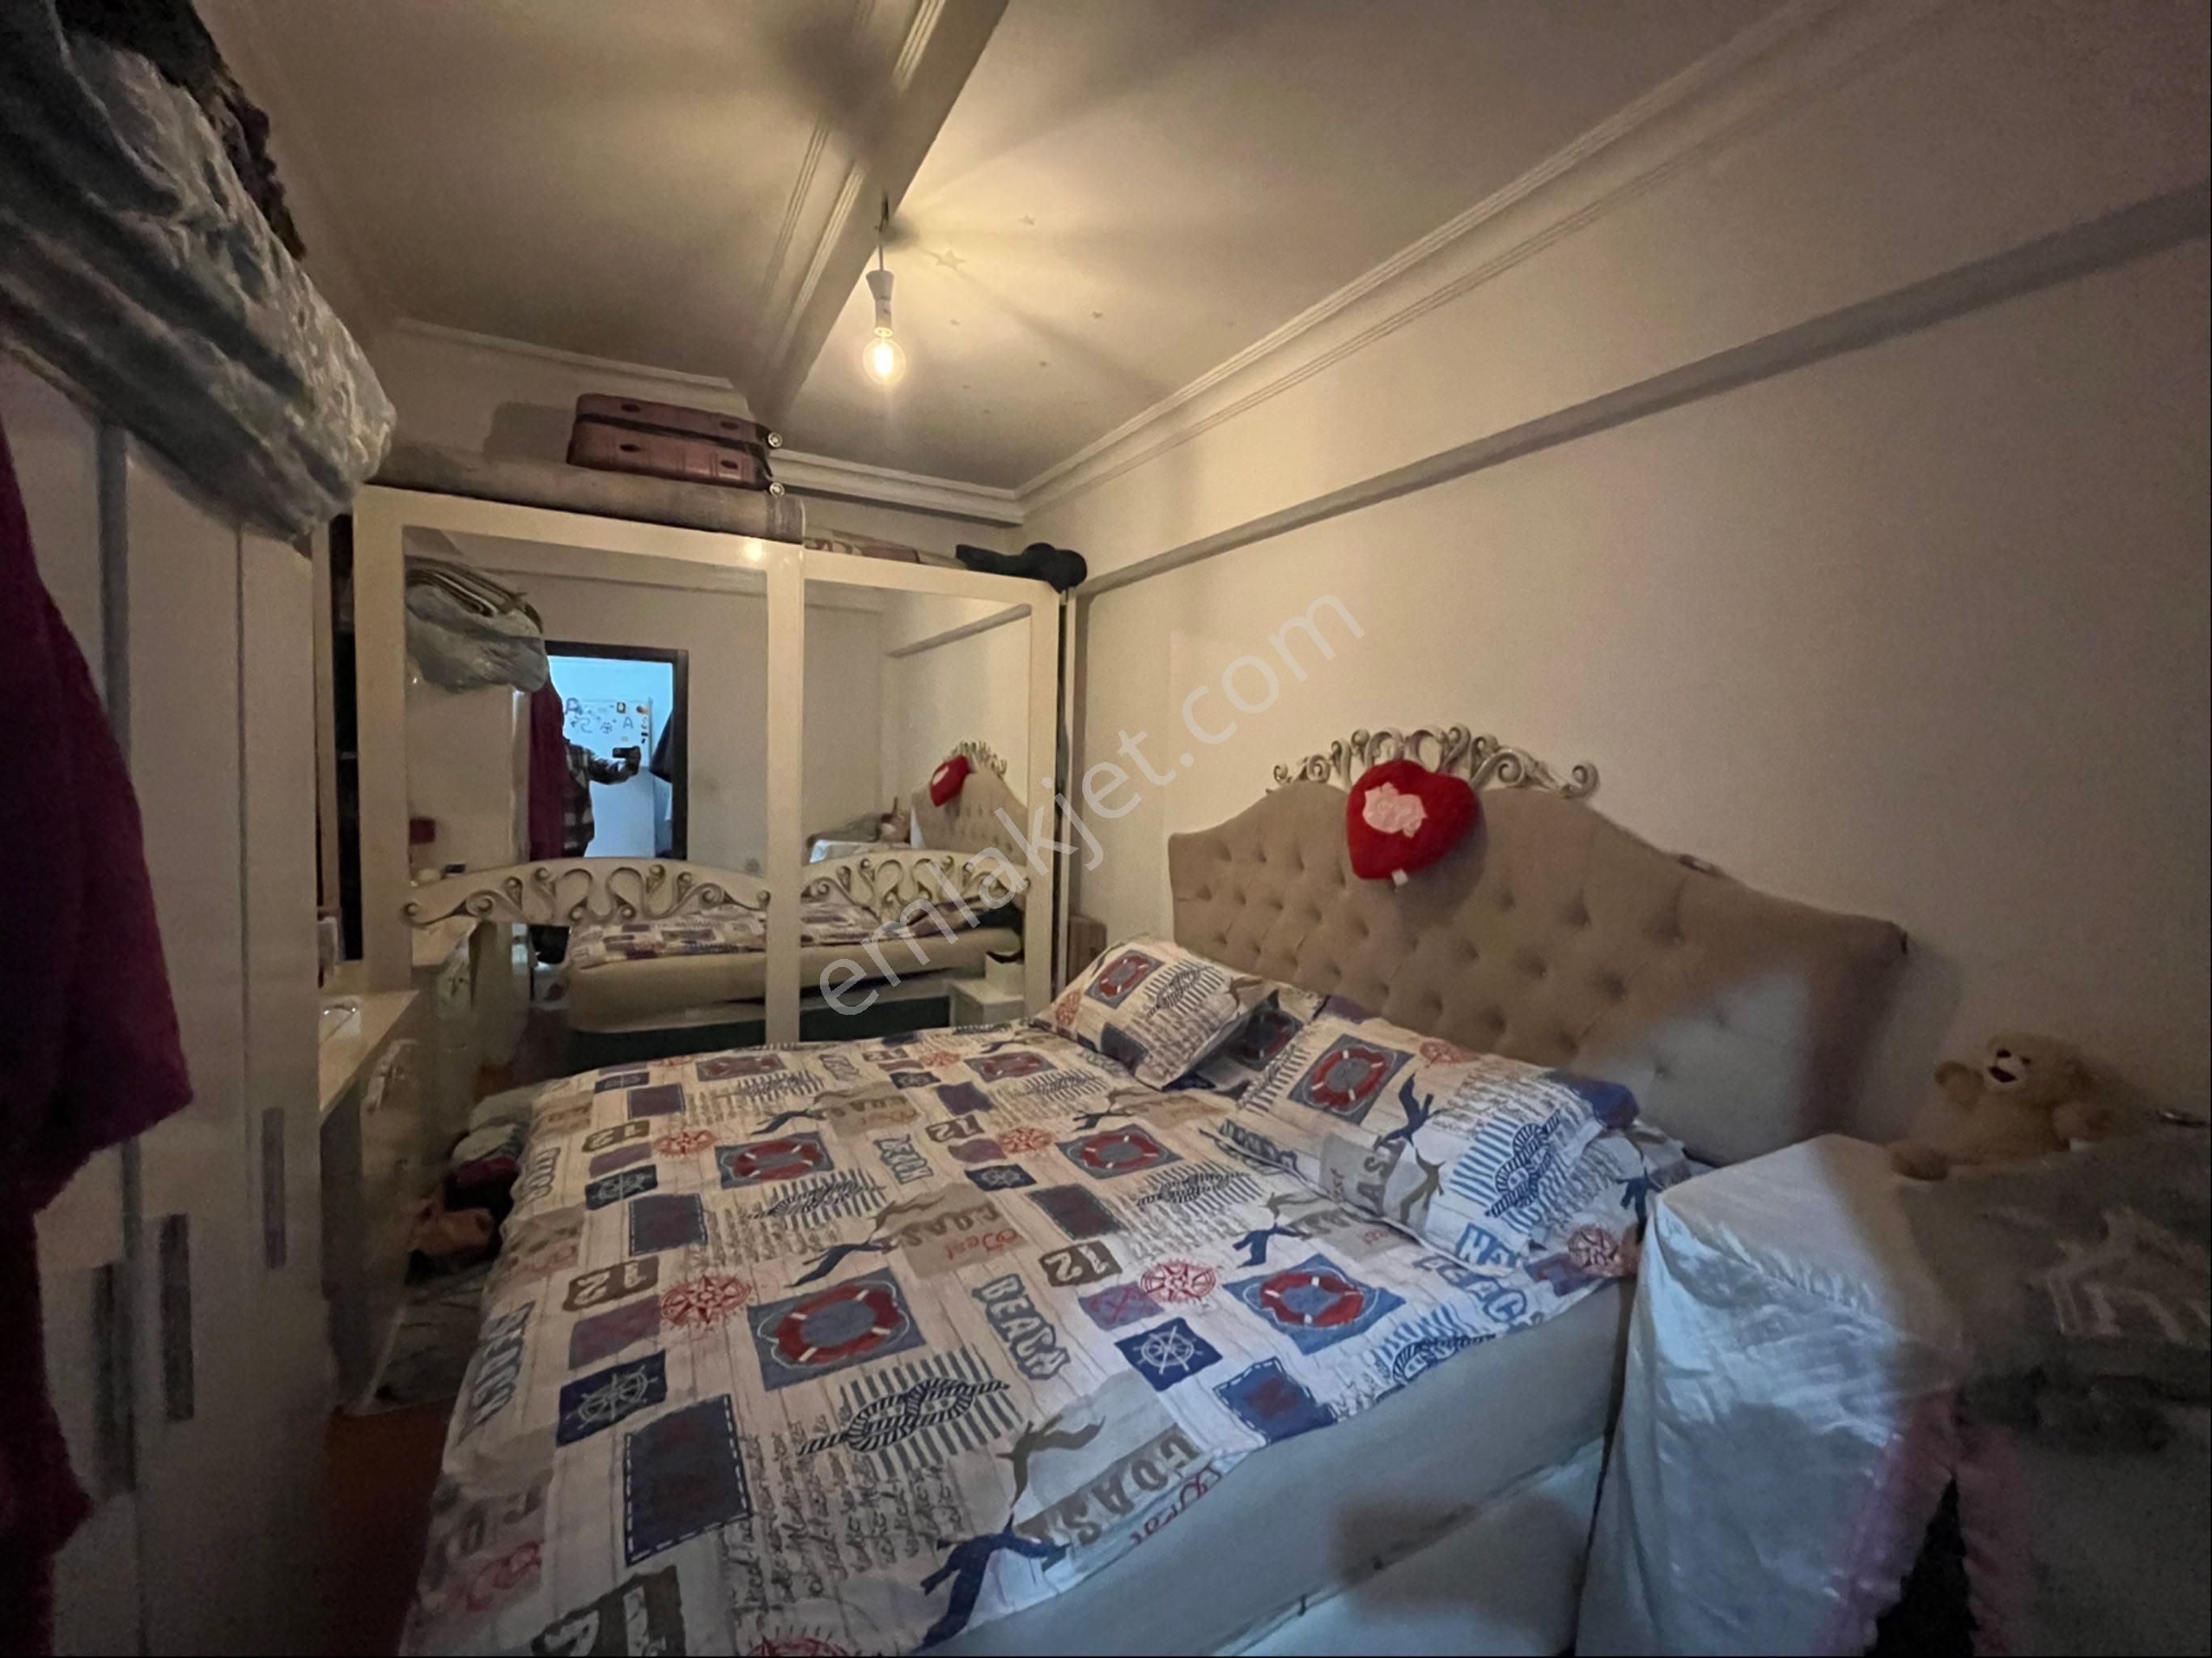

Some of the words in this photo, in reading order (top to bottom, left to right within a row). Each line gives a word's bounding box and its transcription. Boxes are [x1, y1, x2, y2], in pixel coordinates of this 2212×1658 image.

[573, 1262, 647, 1306] 12
[1043, 1245, 1111, 1283] 12
[974, 1274, 1070, 1379] BEACH
